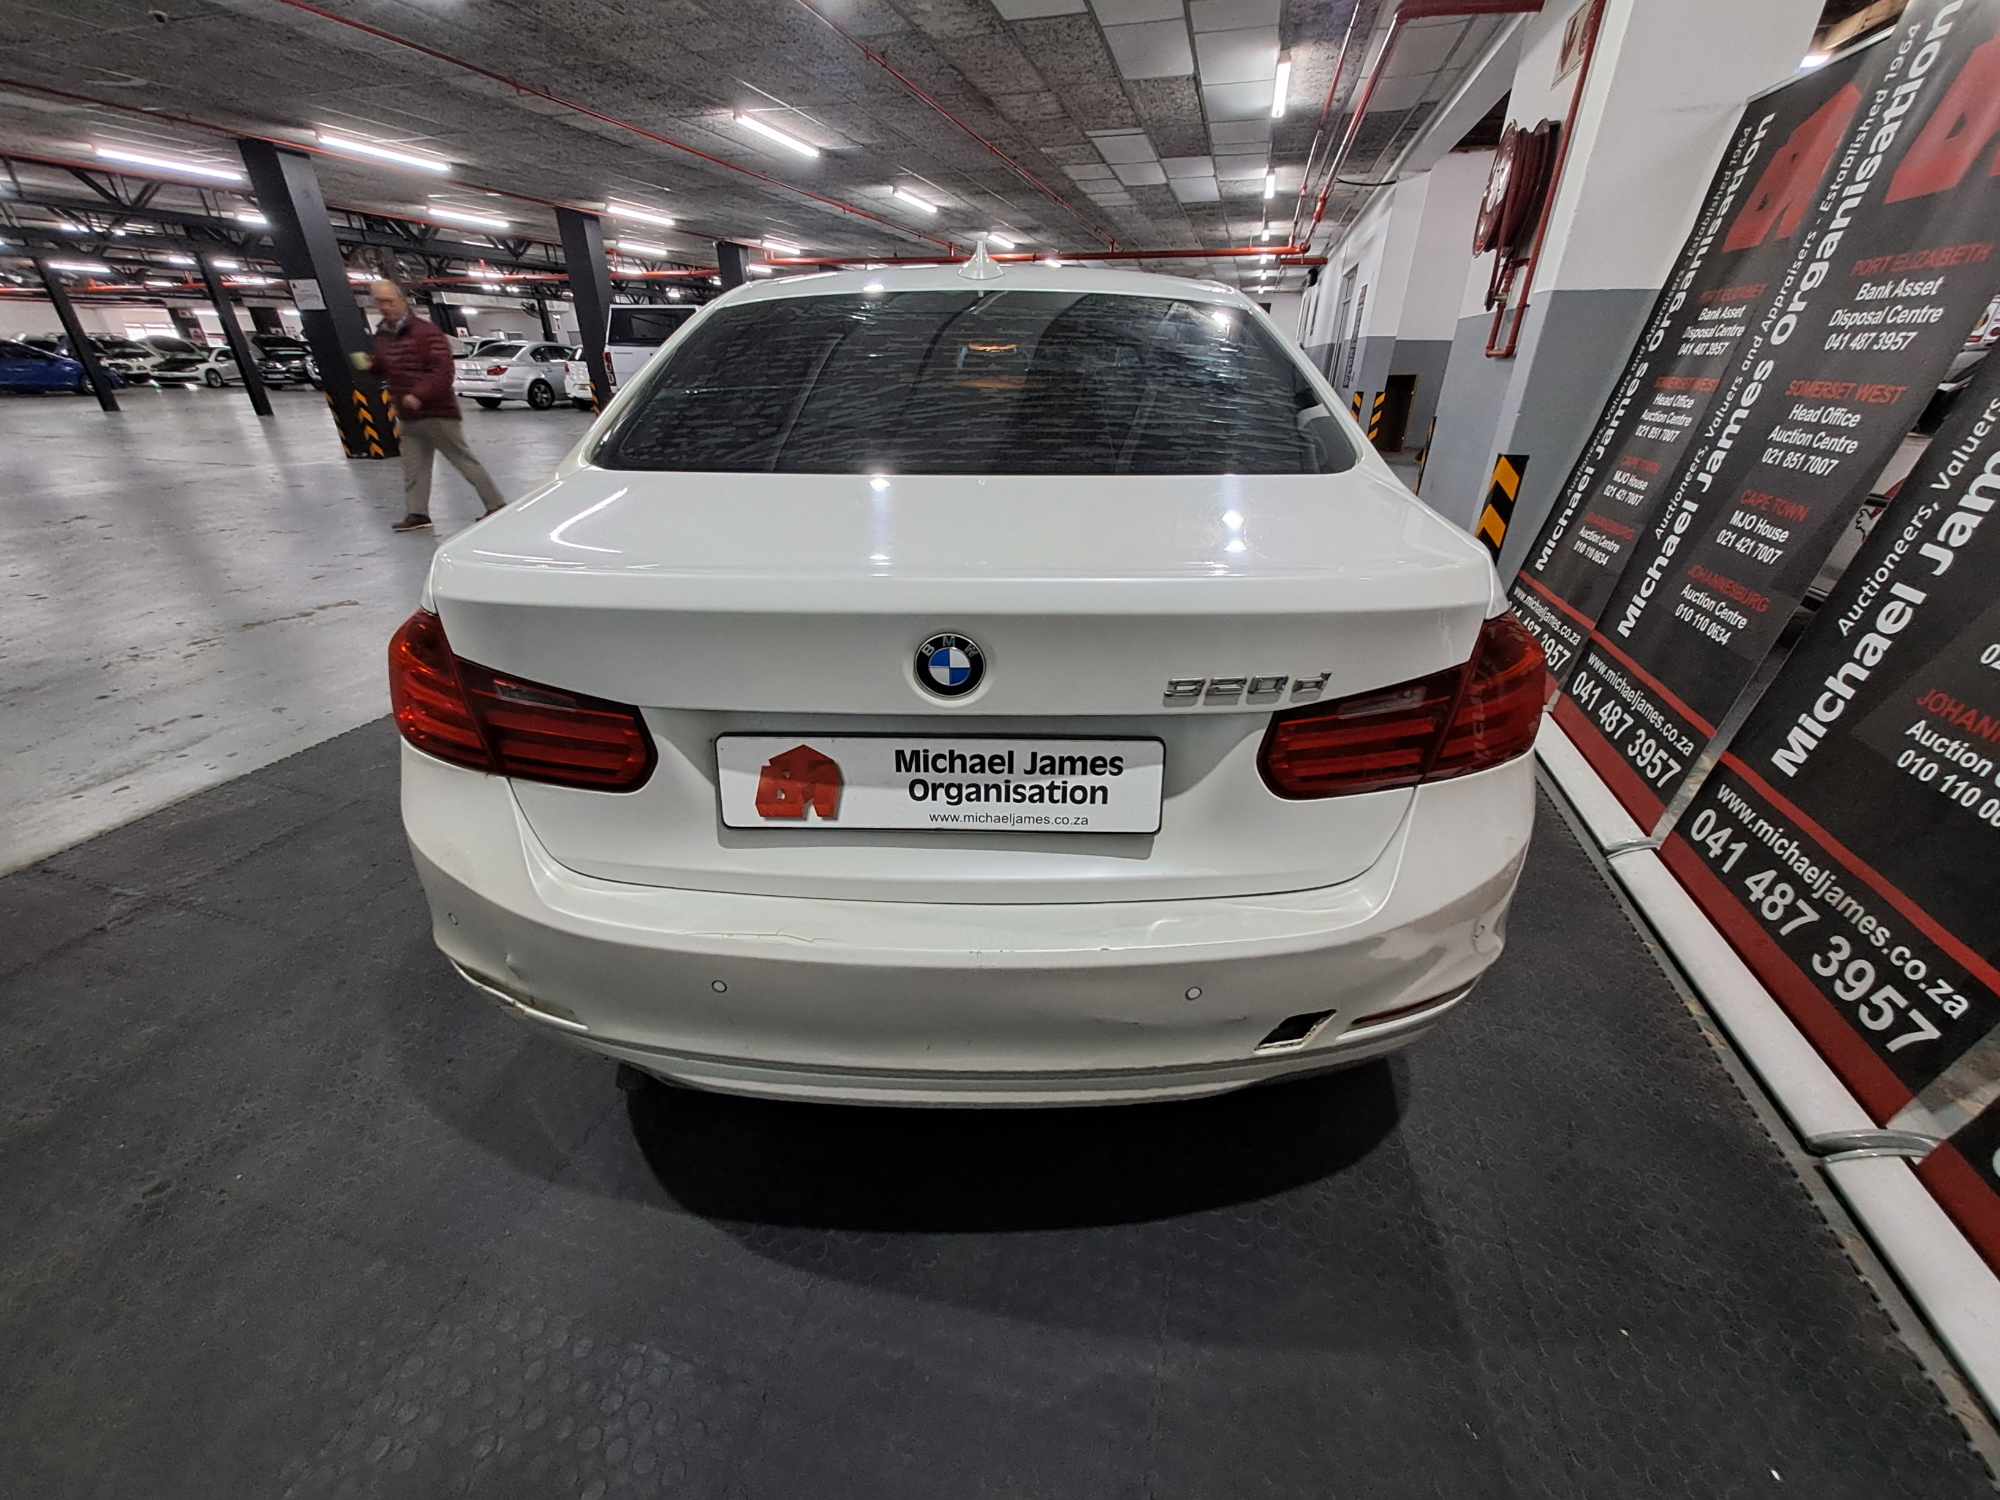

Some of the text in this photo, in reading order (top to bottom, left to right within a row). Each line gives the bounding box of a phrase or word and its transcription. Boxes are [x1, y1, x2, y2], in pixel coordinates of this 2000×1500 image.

[1688, 171, 1732, 256] Established
[1729, 127, 1752, 166] 1964
[1655, 445, 1709, 540] Auctioneers,
[1705, 376, 1743, 438] Valuers
[1741, 335, 1763, 371] and
[1761, 231, 1817, 332] Appraisers
[1819, 89, 1889, 212] Established
[1884, 23, 1920, 82] 1964
[1852, 256, 1891, 277] PORT
[1854, 276, 1945, 301] Bank Asset
[1617, 500, 1699, 638] Michael
[1697, 359, 1775, 492] James
[1770, 0, 1963, 345] Organisation
[1828, 304, 1944, 330] Disposal Centre
[1535, 466, 1595, 571] Michael
[1595, 362, 1648, 460] James
[1648, 113, 1776, 351] Organisation
[1824, 331, 1919, 350] 041 487 3957
[1788, 404, 1861, 428] Head Office
[1855, 384, 1910, 405] WEST
[1767, 425, 1859, 455] Auction Centre
[1761, 447, 1840, 477] 021 851 7007
[1729, 510, 1789, 543] MJO House
[1837, 398, 2000, 637] Auctioneers, Valuers
[1716, 529, 1783, 566] 021 421 7007
[1675, 603, 1732, 646] 010 110 0634
[1681, 583, 1748, 630] Auction Centre
[1771, 582, 1928, 778] Michael
[1587, 652, 1695, 757] www.michaeljames.co.za
[1572, 671, 1682, 788] 041 487 3957
[1905, 719, 1993, 778] Auction
[894, 749, 1125, 778] Michael James
[1897, 749, 1939, 783] 010
[1939, 774, 1981, 808] 110
[908, 779, 1109, 806] Organisation
[929, 811, 1090, 827] www.michaeljames.co.za
[1717, 783, 1970, 1020] www.michaeljames.co.za
[1690, 808, 1942, 1053] 041 487 3957
